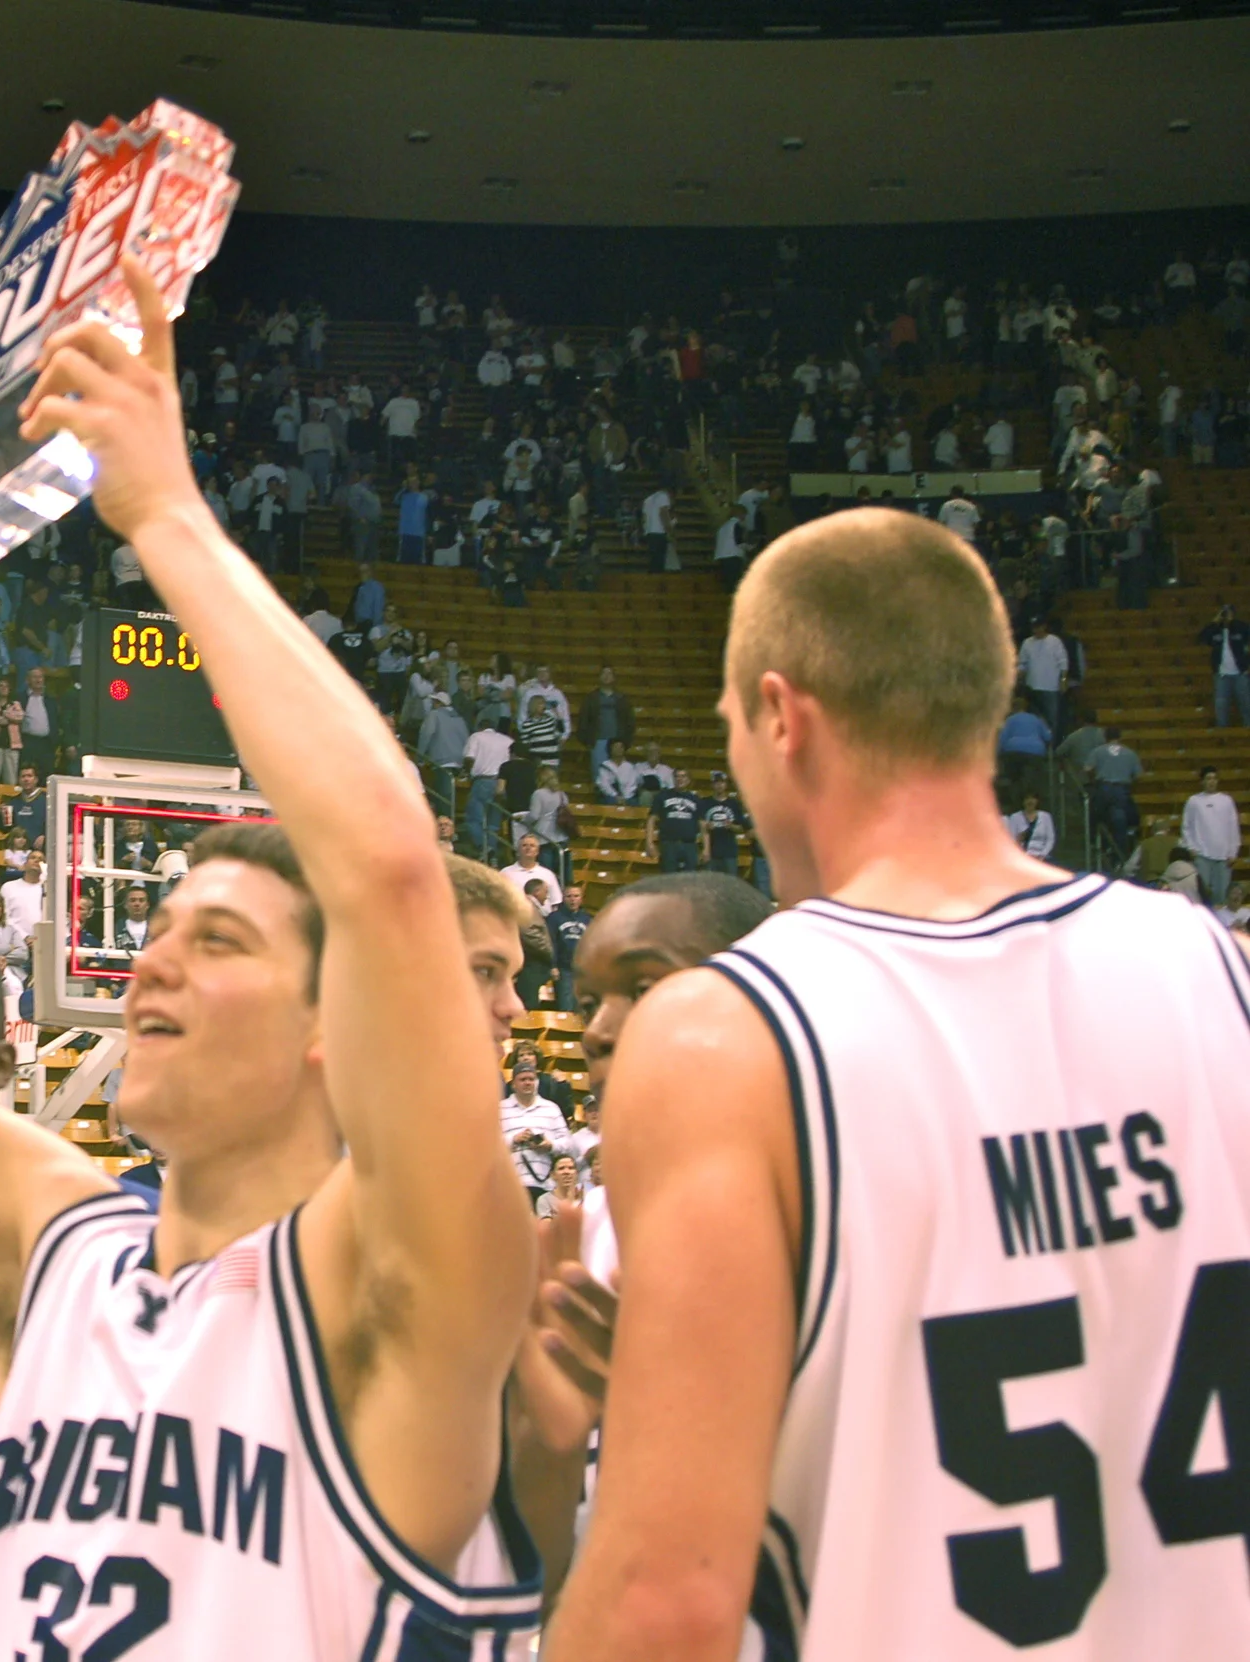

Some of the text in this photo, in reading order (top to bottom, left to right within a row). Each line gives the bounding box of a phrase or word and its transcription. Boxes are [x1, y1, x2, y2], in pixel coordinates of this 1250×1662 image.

[112, 624, 201, 671] 00.0
[981, 1110, 1185, 1260] MILES
[920, 1257, 1250, 1650] 54
[13, 1554, 172, 1662] 32
